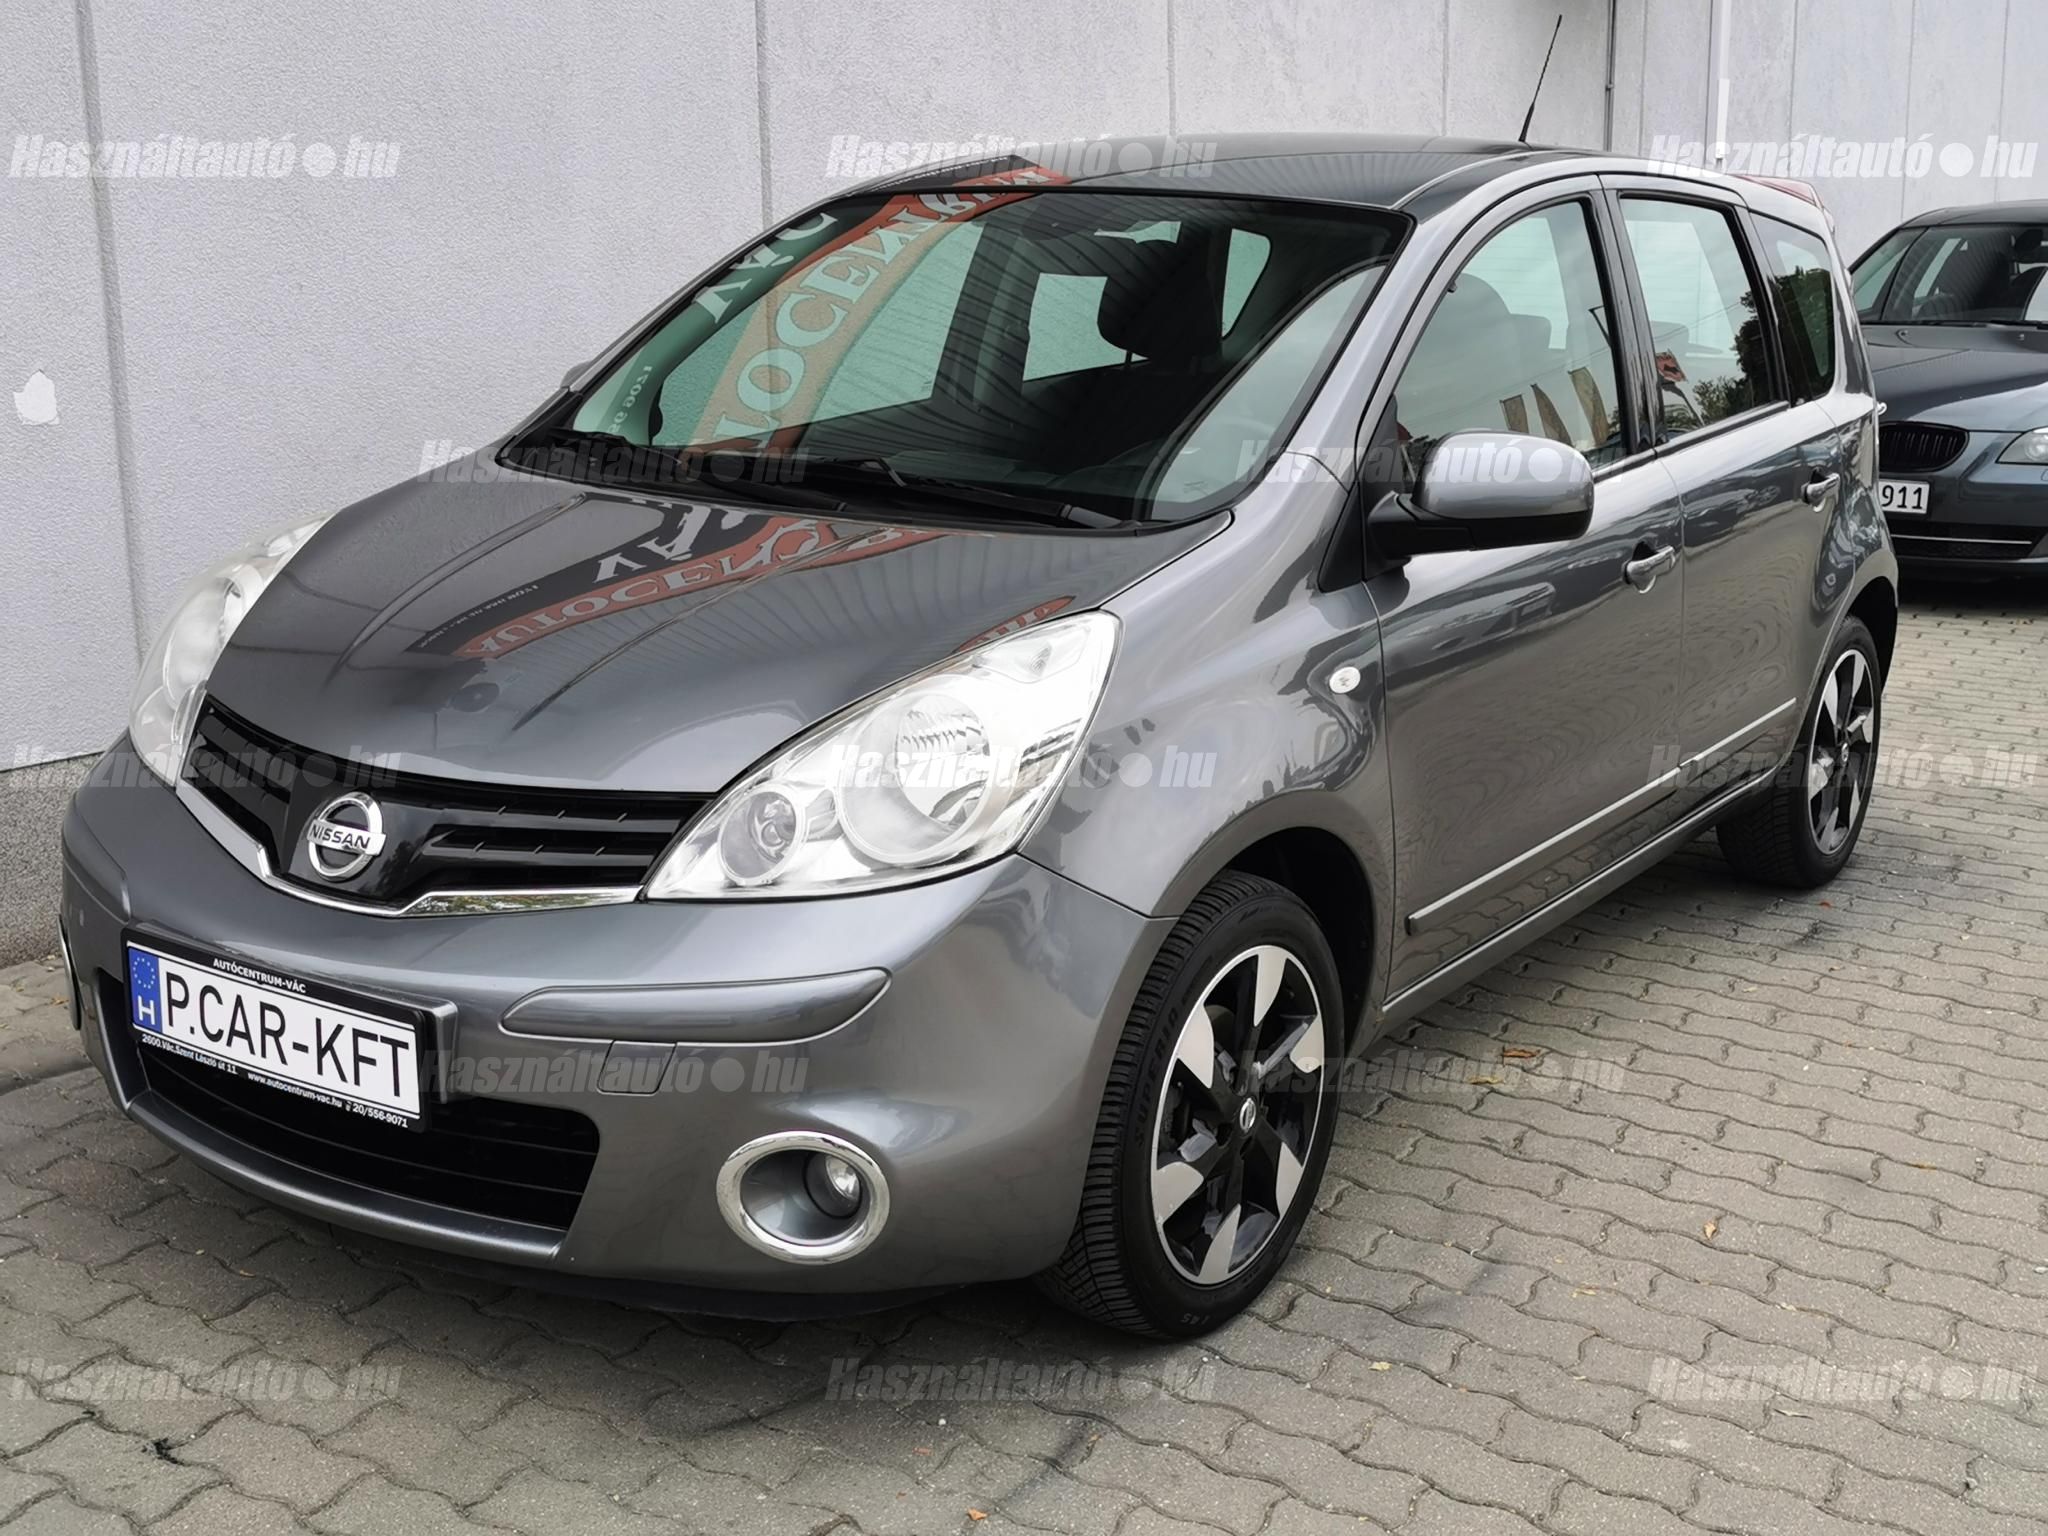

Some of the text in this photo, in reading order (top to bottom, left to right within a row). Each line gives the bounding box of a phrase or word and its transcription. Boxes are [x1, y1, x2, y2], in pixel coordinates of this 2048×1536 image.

[1881, 484, 1923, 509] 911
[310, 823, 371, 850] NISSAN
[138, 995, 156, 1026] H
[166, 971, 409, 1098] P.CAR-KFT
